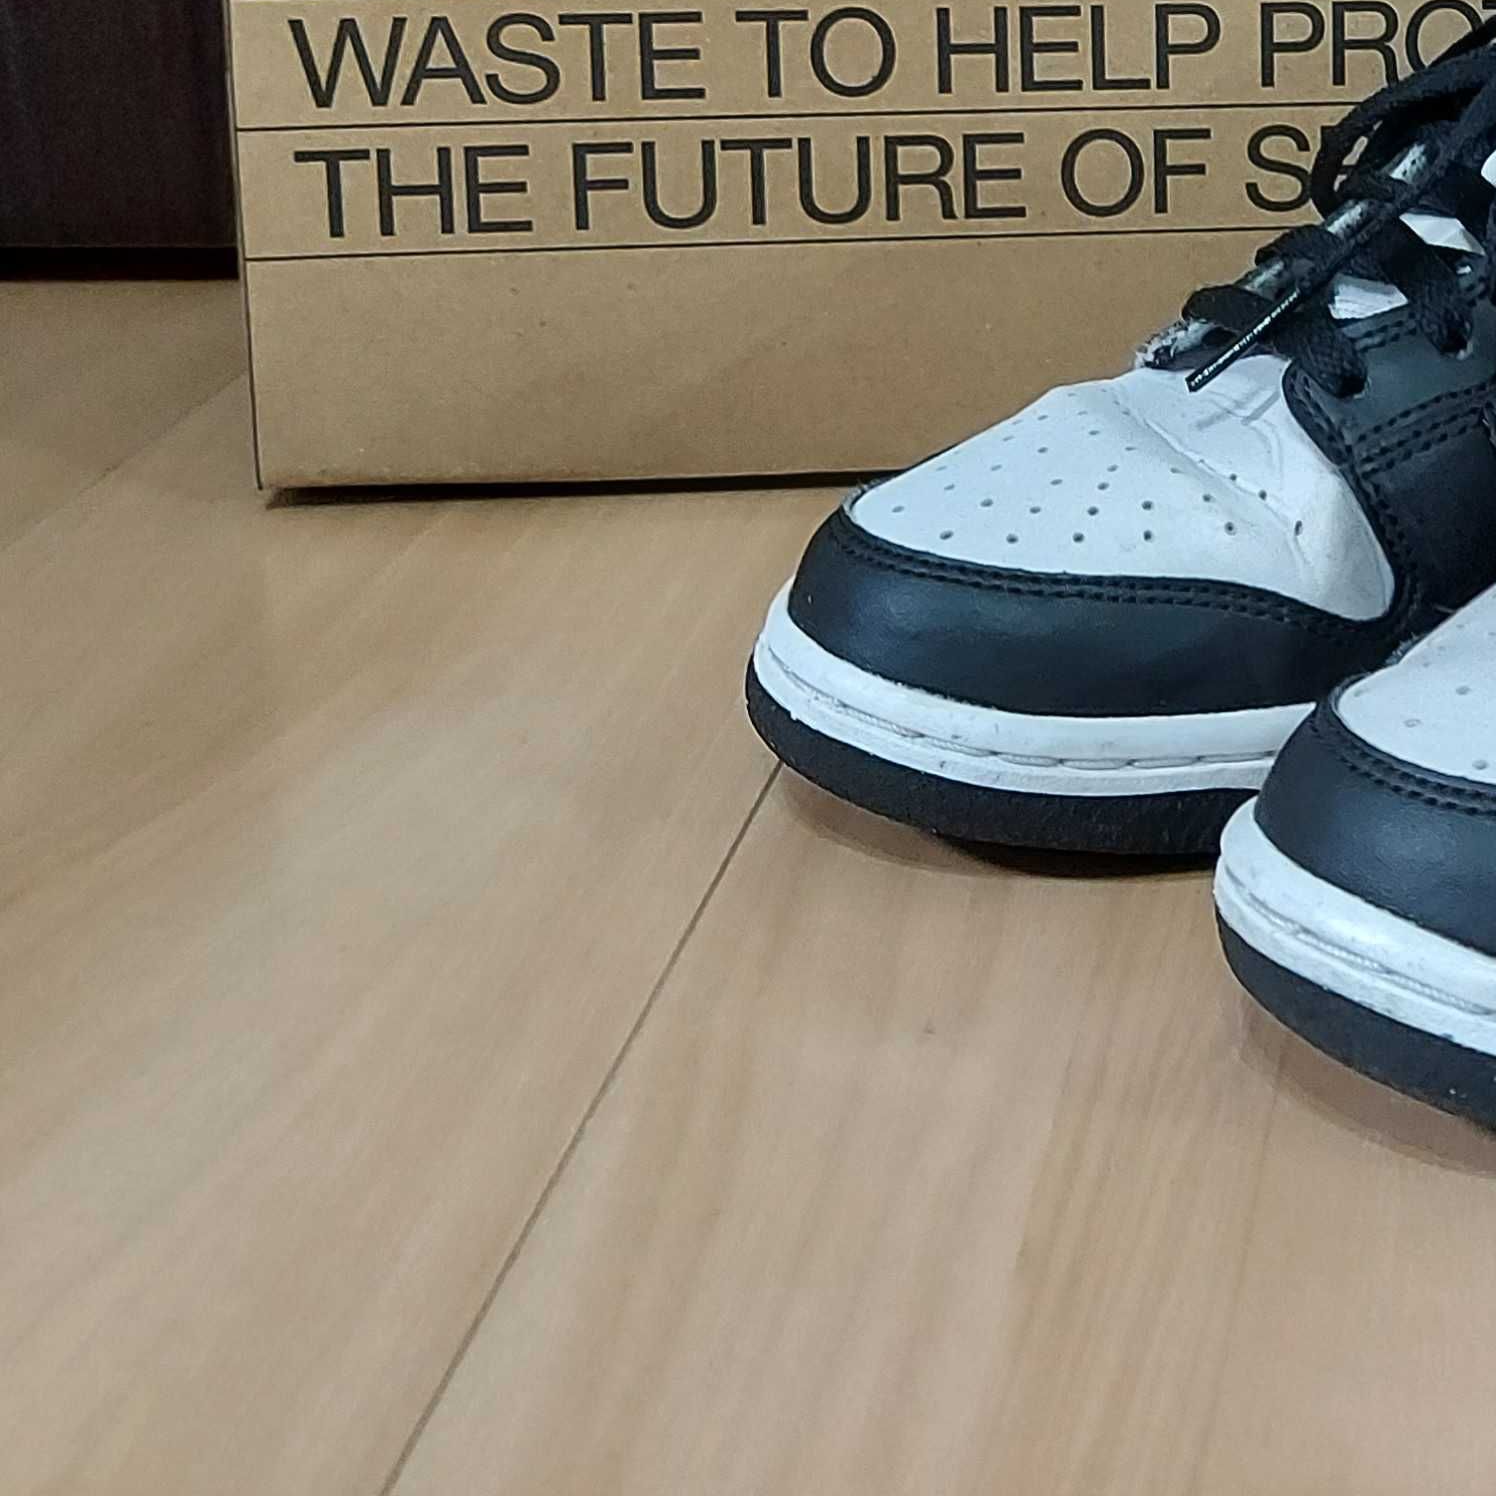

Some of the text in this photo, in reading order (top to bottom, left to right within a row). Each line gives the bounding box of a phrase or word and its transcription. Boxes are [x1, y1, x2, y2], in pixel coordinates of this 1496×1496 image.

[287, 11, 706, 109] WASTE
[734, 6, 896, 100] TO
[935, 3, 1221, 95] HELP
[293, 144, 534, 239] THE
[571, 132, 1027, 231] FUTURE
[1060, 127, 1212, 218] OF
